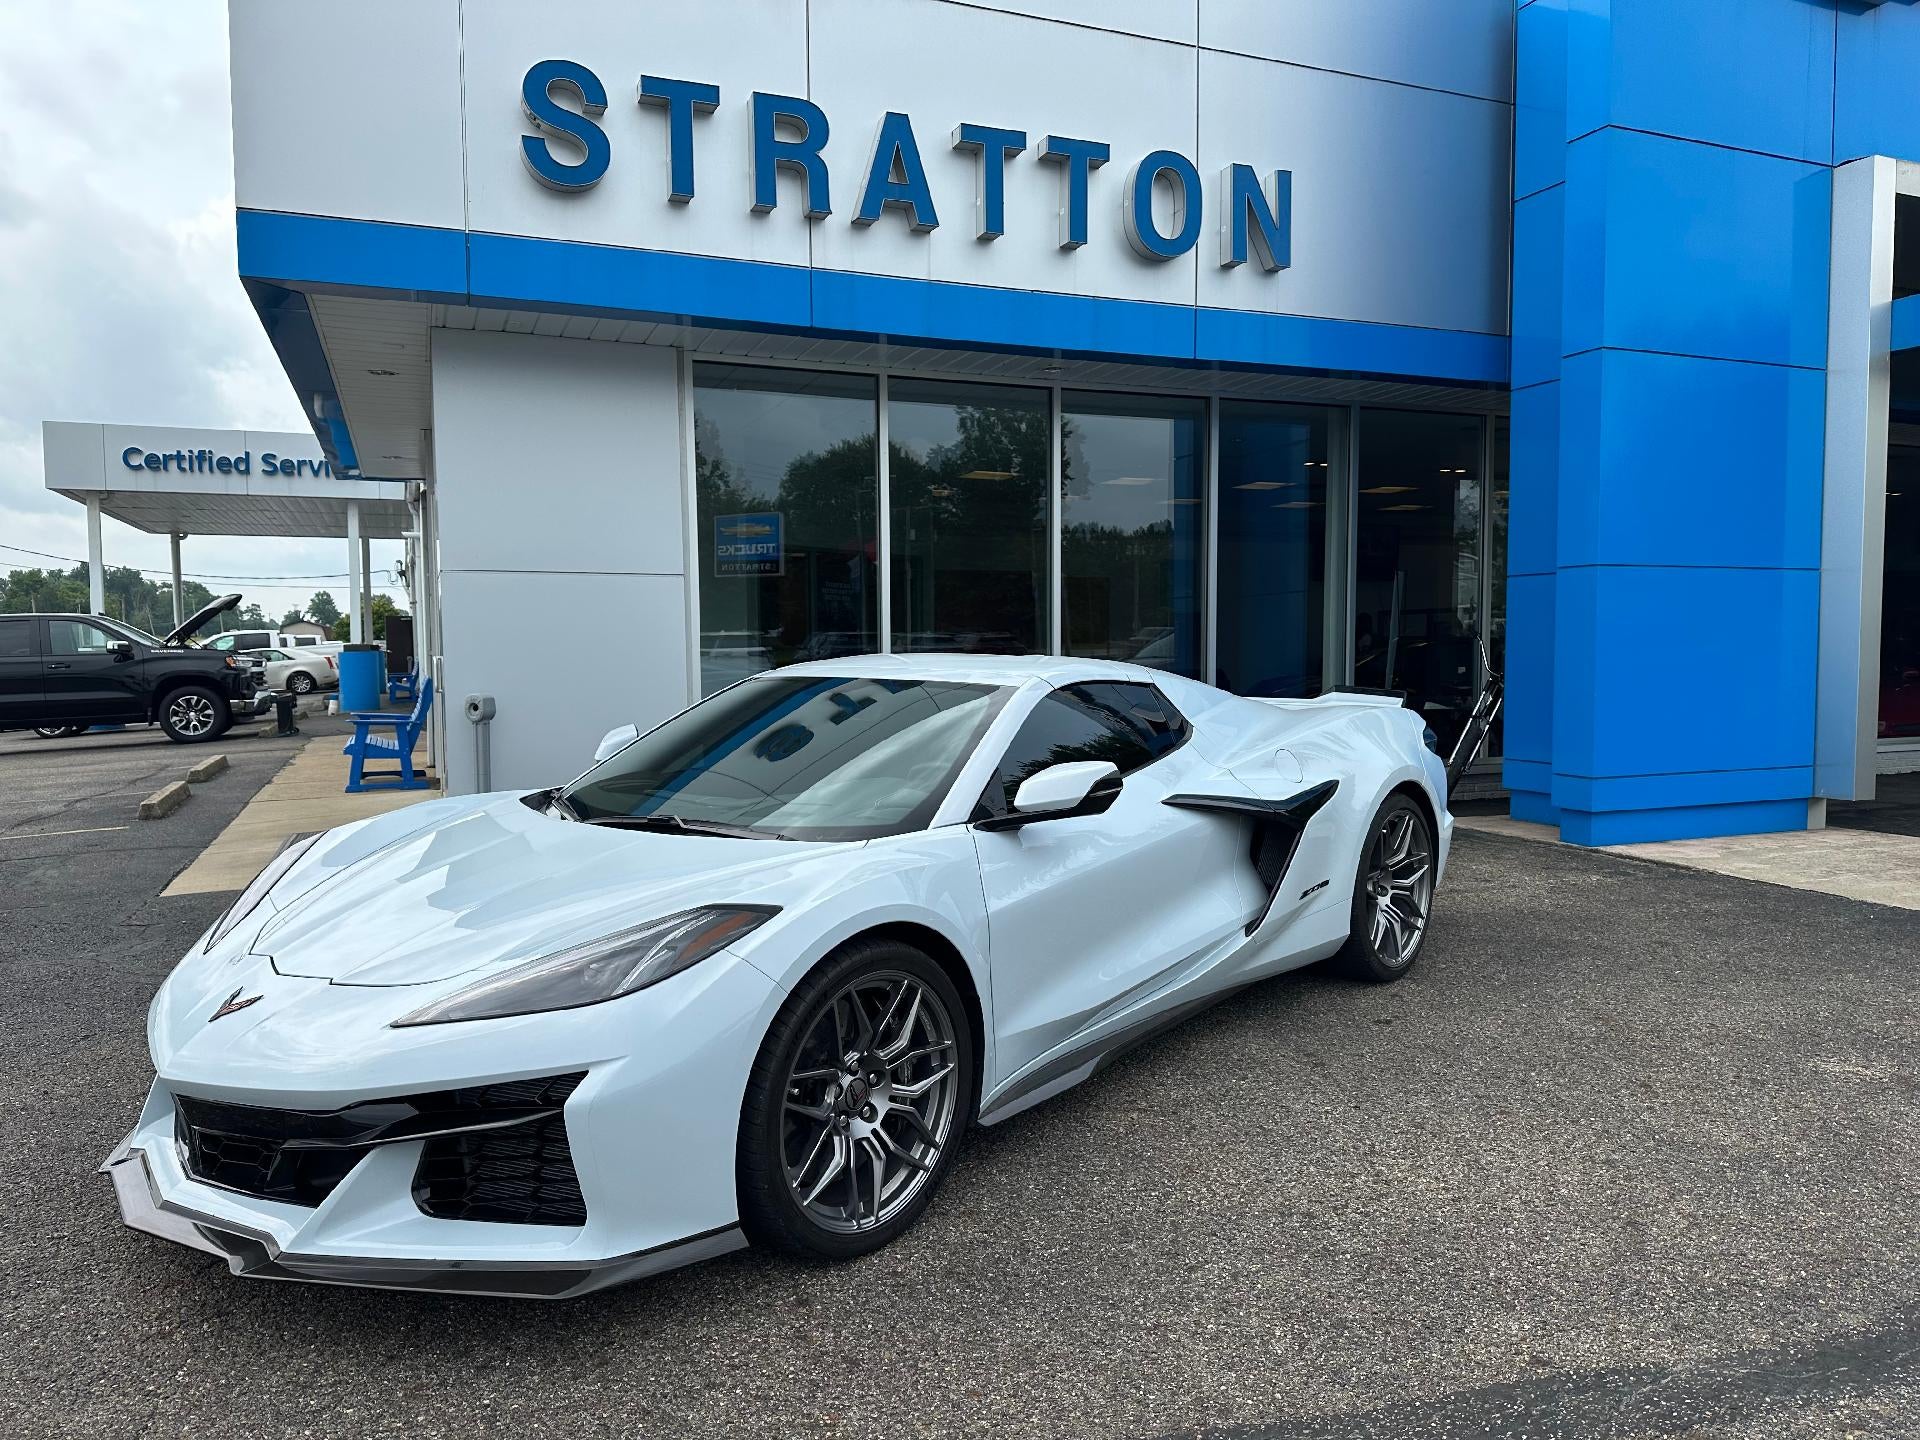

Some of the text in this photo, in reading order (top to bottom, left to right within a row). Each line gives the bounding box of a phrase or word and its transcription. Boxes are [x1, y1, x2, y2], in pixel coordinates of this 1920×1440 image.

[520, 59, 1293, 272] STRATTON
[122, 446, 331, 478] Certified Servi
